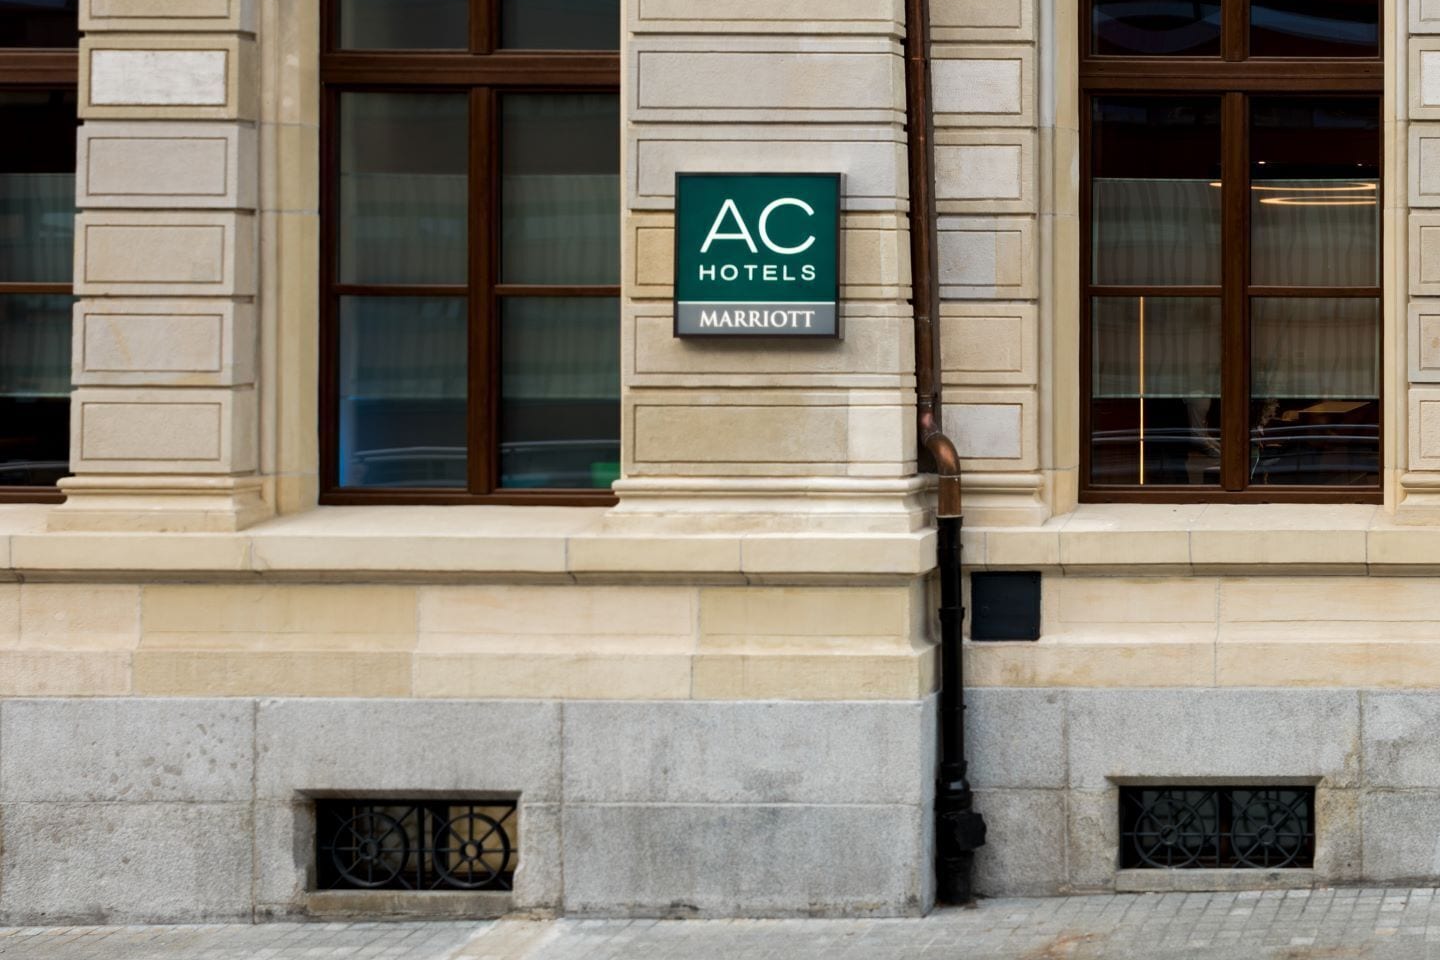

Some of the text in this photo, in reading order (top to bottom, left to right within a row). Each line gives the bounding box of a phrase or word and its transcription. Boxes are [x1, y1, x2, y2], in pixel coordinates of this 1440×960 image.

[700, 197, 816, 255] AC
[699, 264, 816, 281] HOTELS
[700, 310, 815, 328] MARRIOTT
